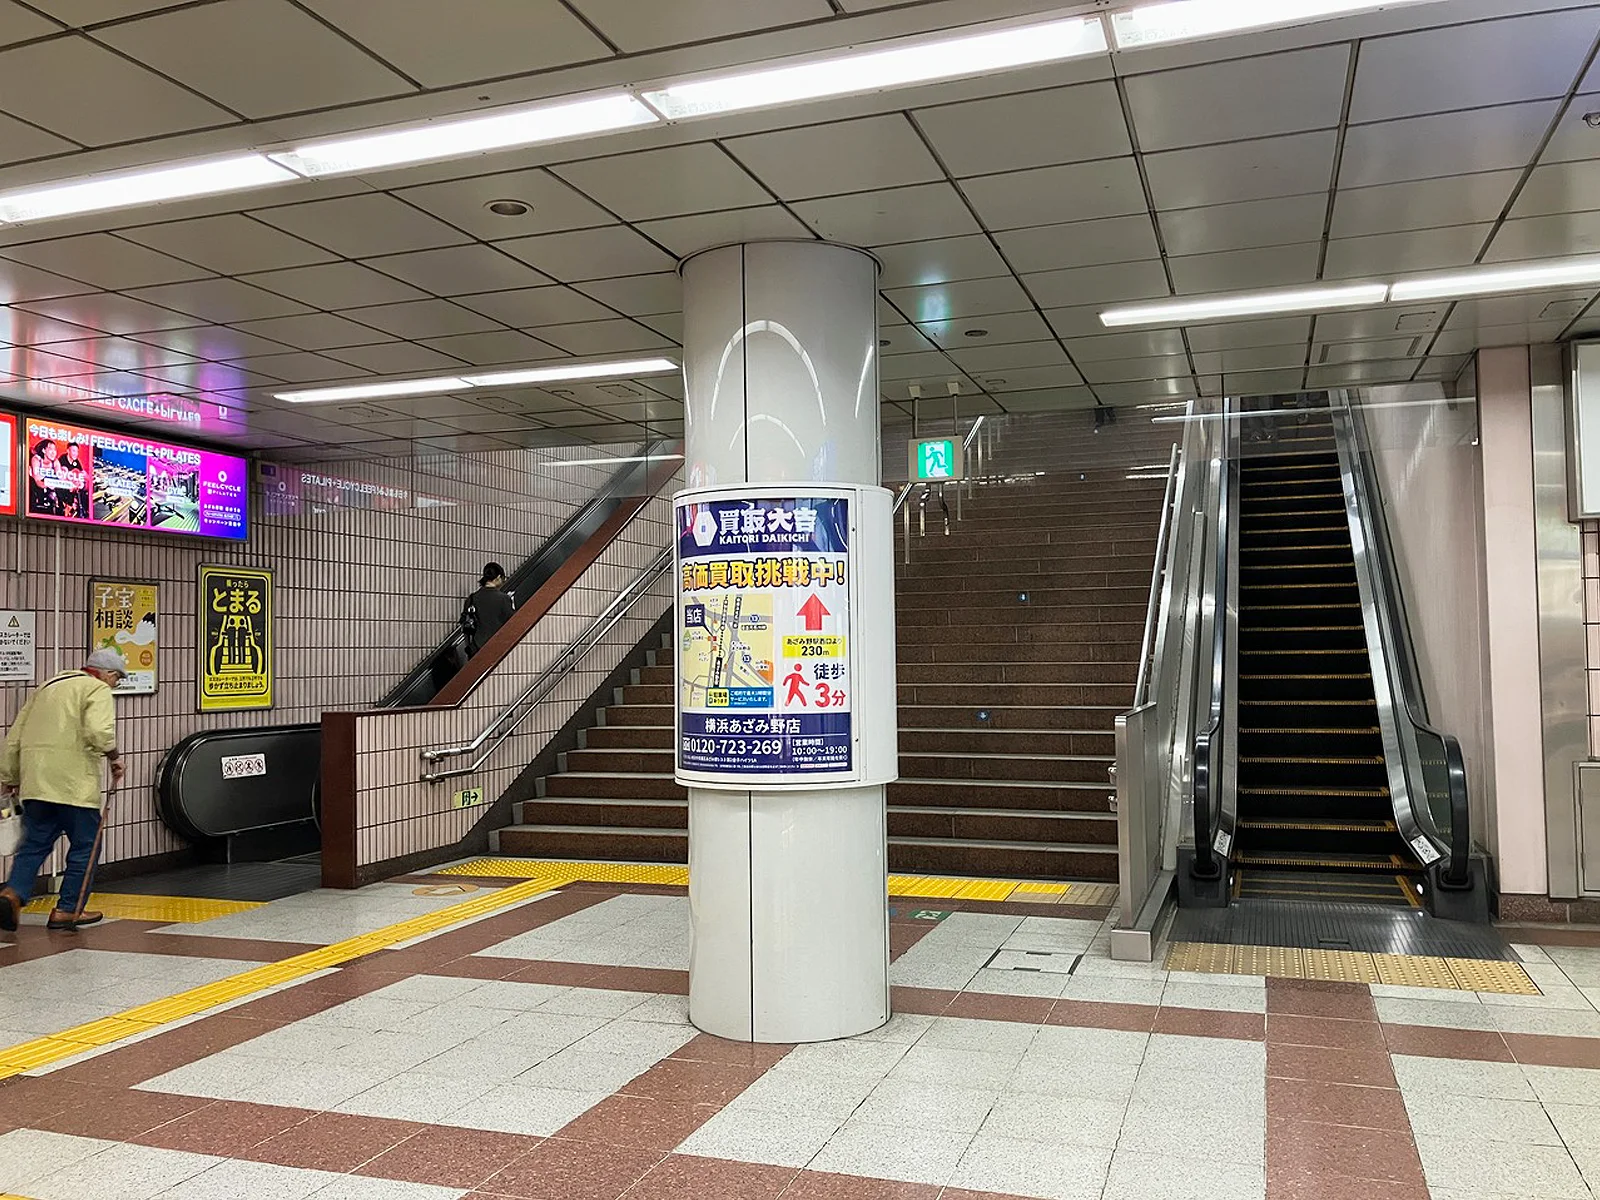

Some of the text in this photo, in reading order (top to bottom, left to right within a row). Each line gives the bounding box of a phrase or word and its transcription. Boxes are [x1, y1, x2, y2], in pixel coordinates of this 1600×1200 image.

[29, 424, 201, 465] 今日も楽しみ! FEELCYCLE+PILATES
[203, 481, 241, 492] FEELCYCLE
[718, 507, 818, 535] 買取大吉
[719, 533, 809, 545] KAITORI DAIKICHI
[226, 579, 249, 589] ったら
[95, 586, 134, 608] 子宝
[212, 588, 261, 614] とまる
[94, 608, 134, 629] 相談
[801, 645, 830, 656] 230m
[813, 662, 846, 680] 徒歩
[815, 682, 846, 708] 3分
[704, 717, 801, 734] 横浜あざみ野店
[691, 739, 782, 756] 0120-723-269
